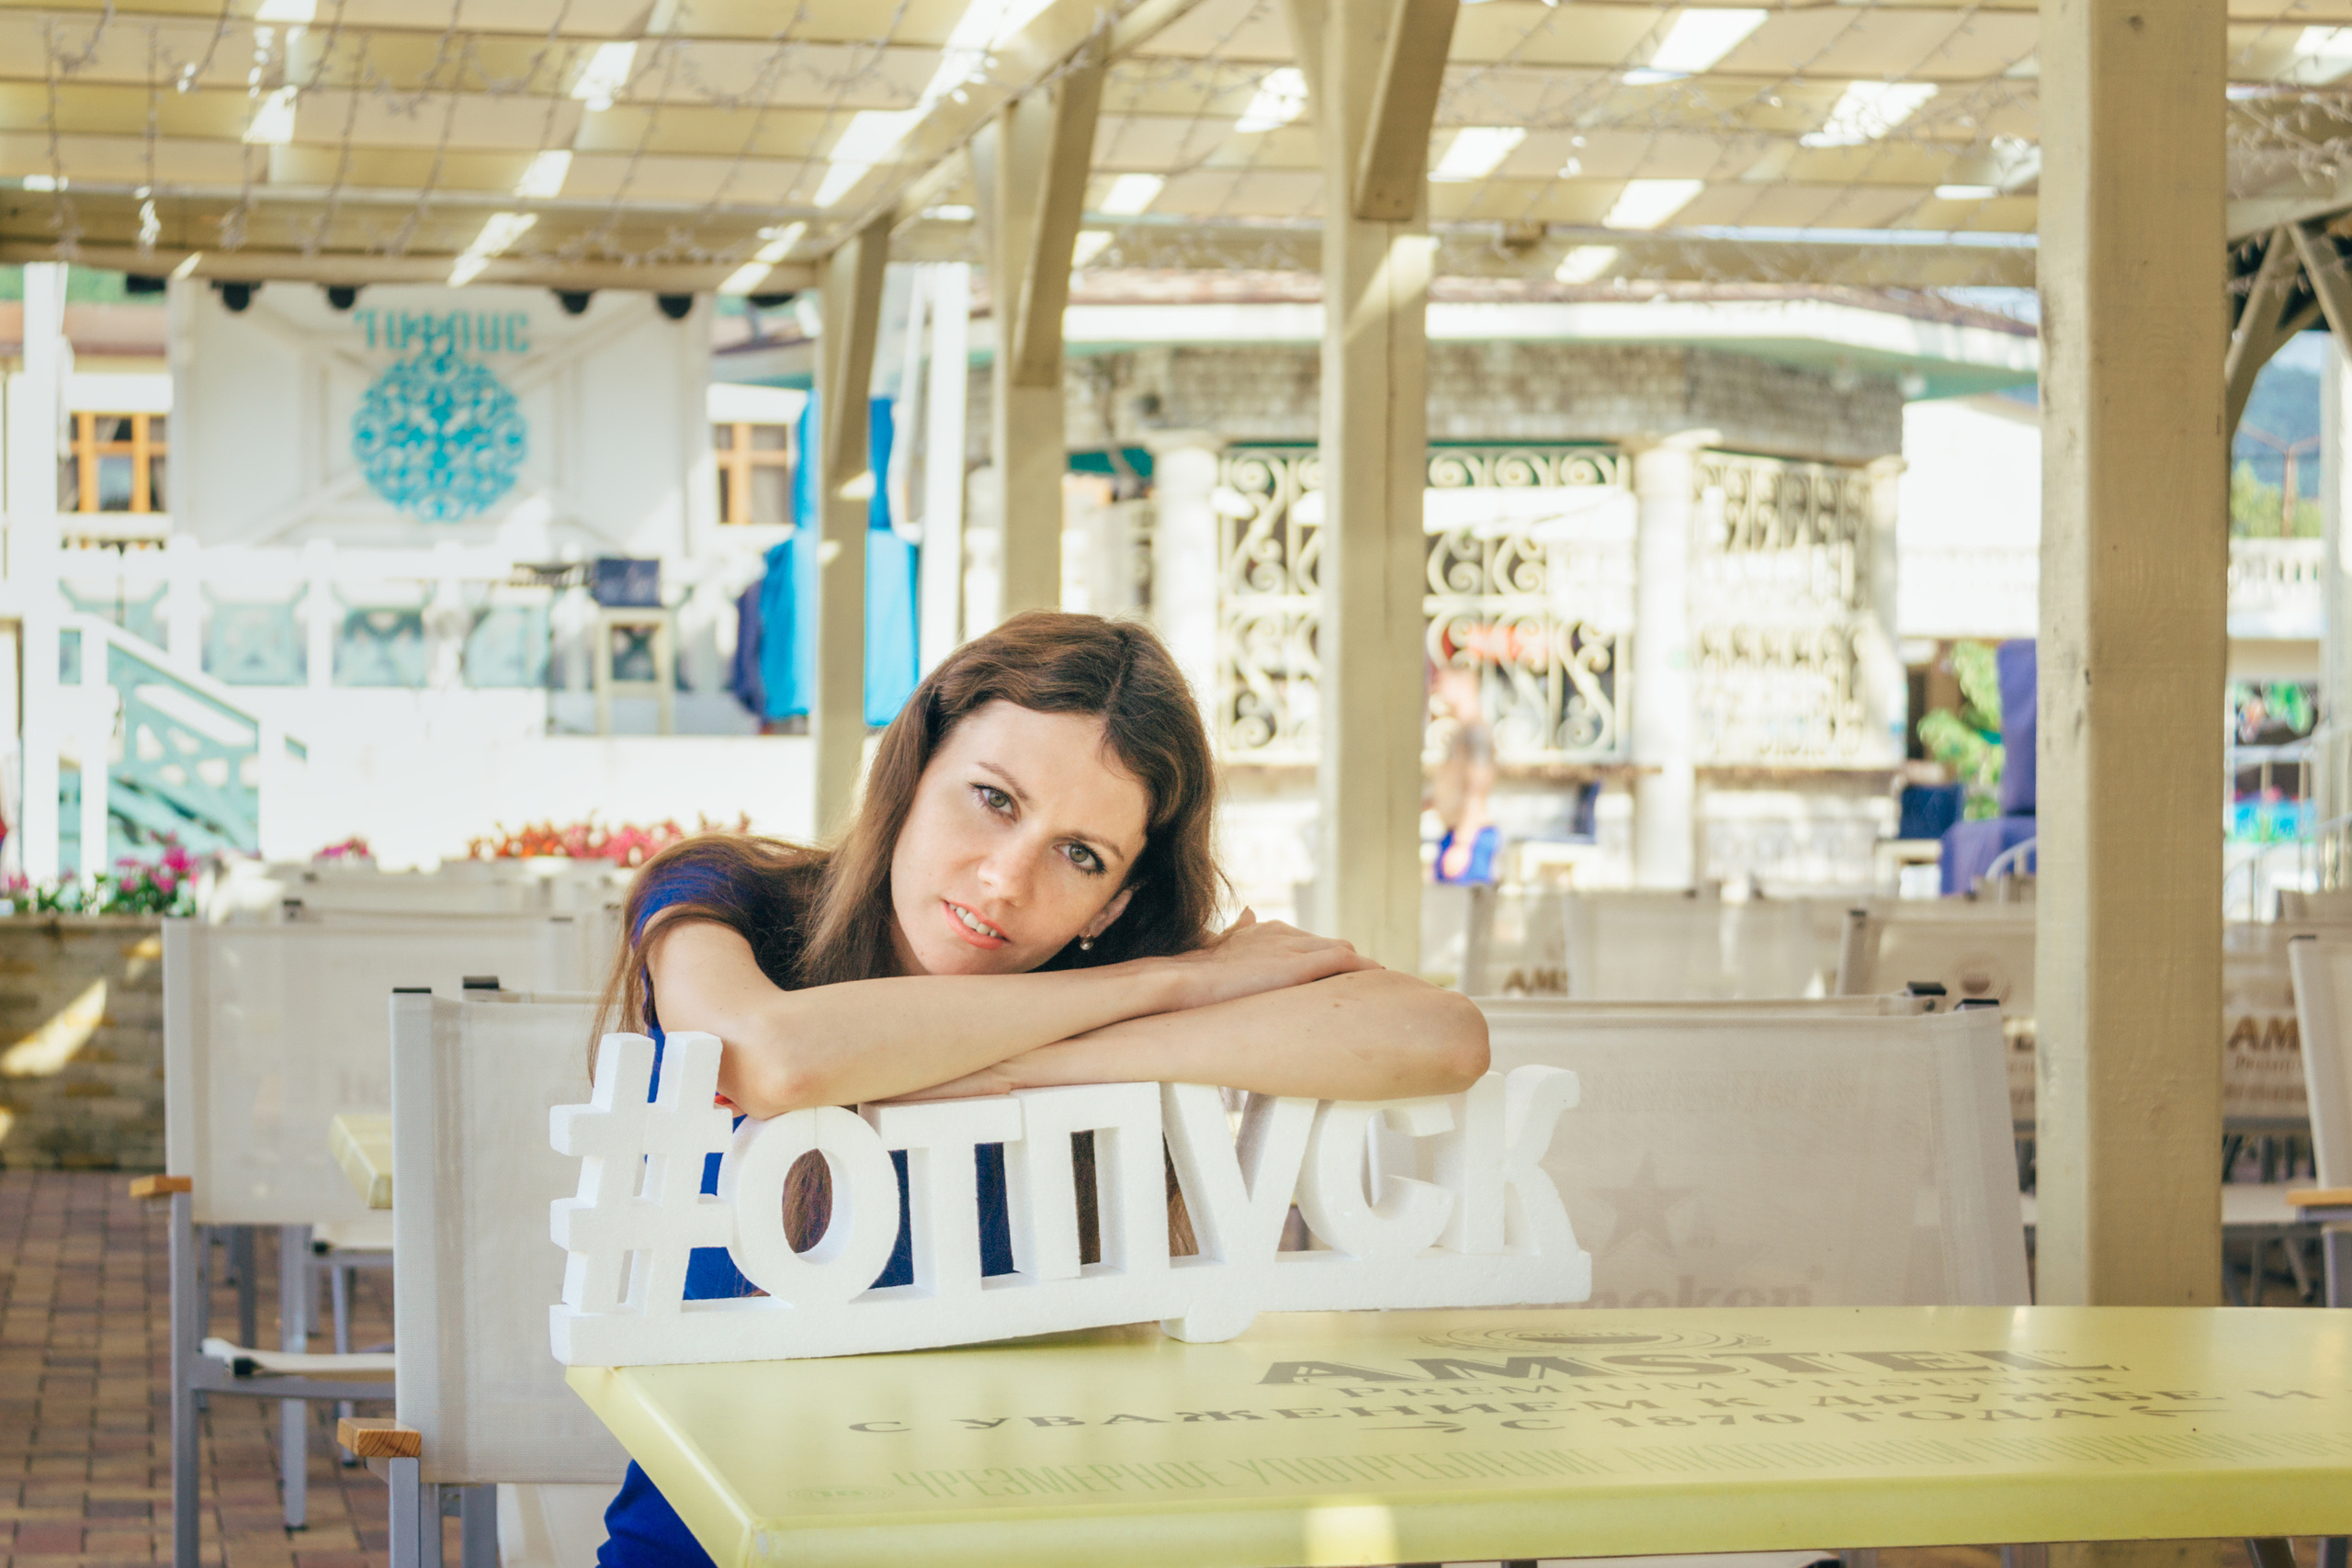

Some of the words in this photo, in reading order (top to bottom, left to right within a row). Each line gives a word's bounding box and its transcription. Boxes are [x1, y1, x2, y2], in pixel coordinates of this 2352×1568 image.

[1259, 1349, 2130, 1383] AMSTEL
[848, 1421, 913, 1433] С
[949, 1399, 1668, 1429] УВАЖЕНИЕМ
[1695, 1396, 1769, 1408] К
[1812, 1390, 2227, 1407] ДРУЖБЕ
[1601, 1413, 1805, 1428] 1870
[1838, 1407, 2119, 1422] ГОДА
[890, 1461, 1239, 1498] ЧРЕЗМЕРНОЕ
[1227, 1449, 1629, 1485] УПОТРЕБЛЕНИЕ
[1614, 1436, 1990, 1472] АЛКОГОЛЬНОЙ
[1962, 1434, 2285, 1465] ПРОДУКЦИИ
